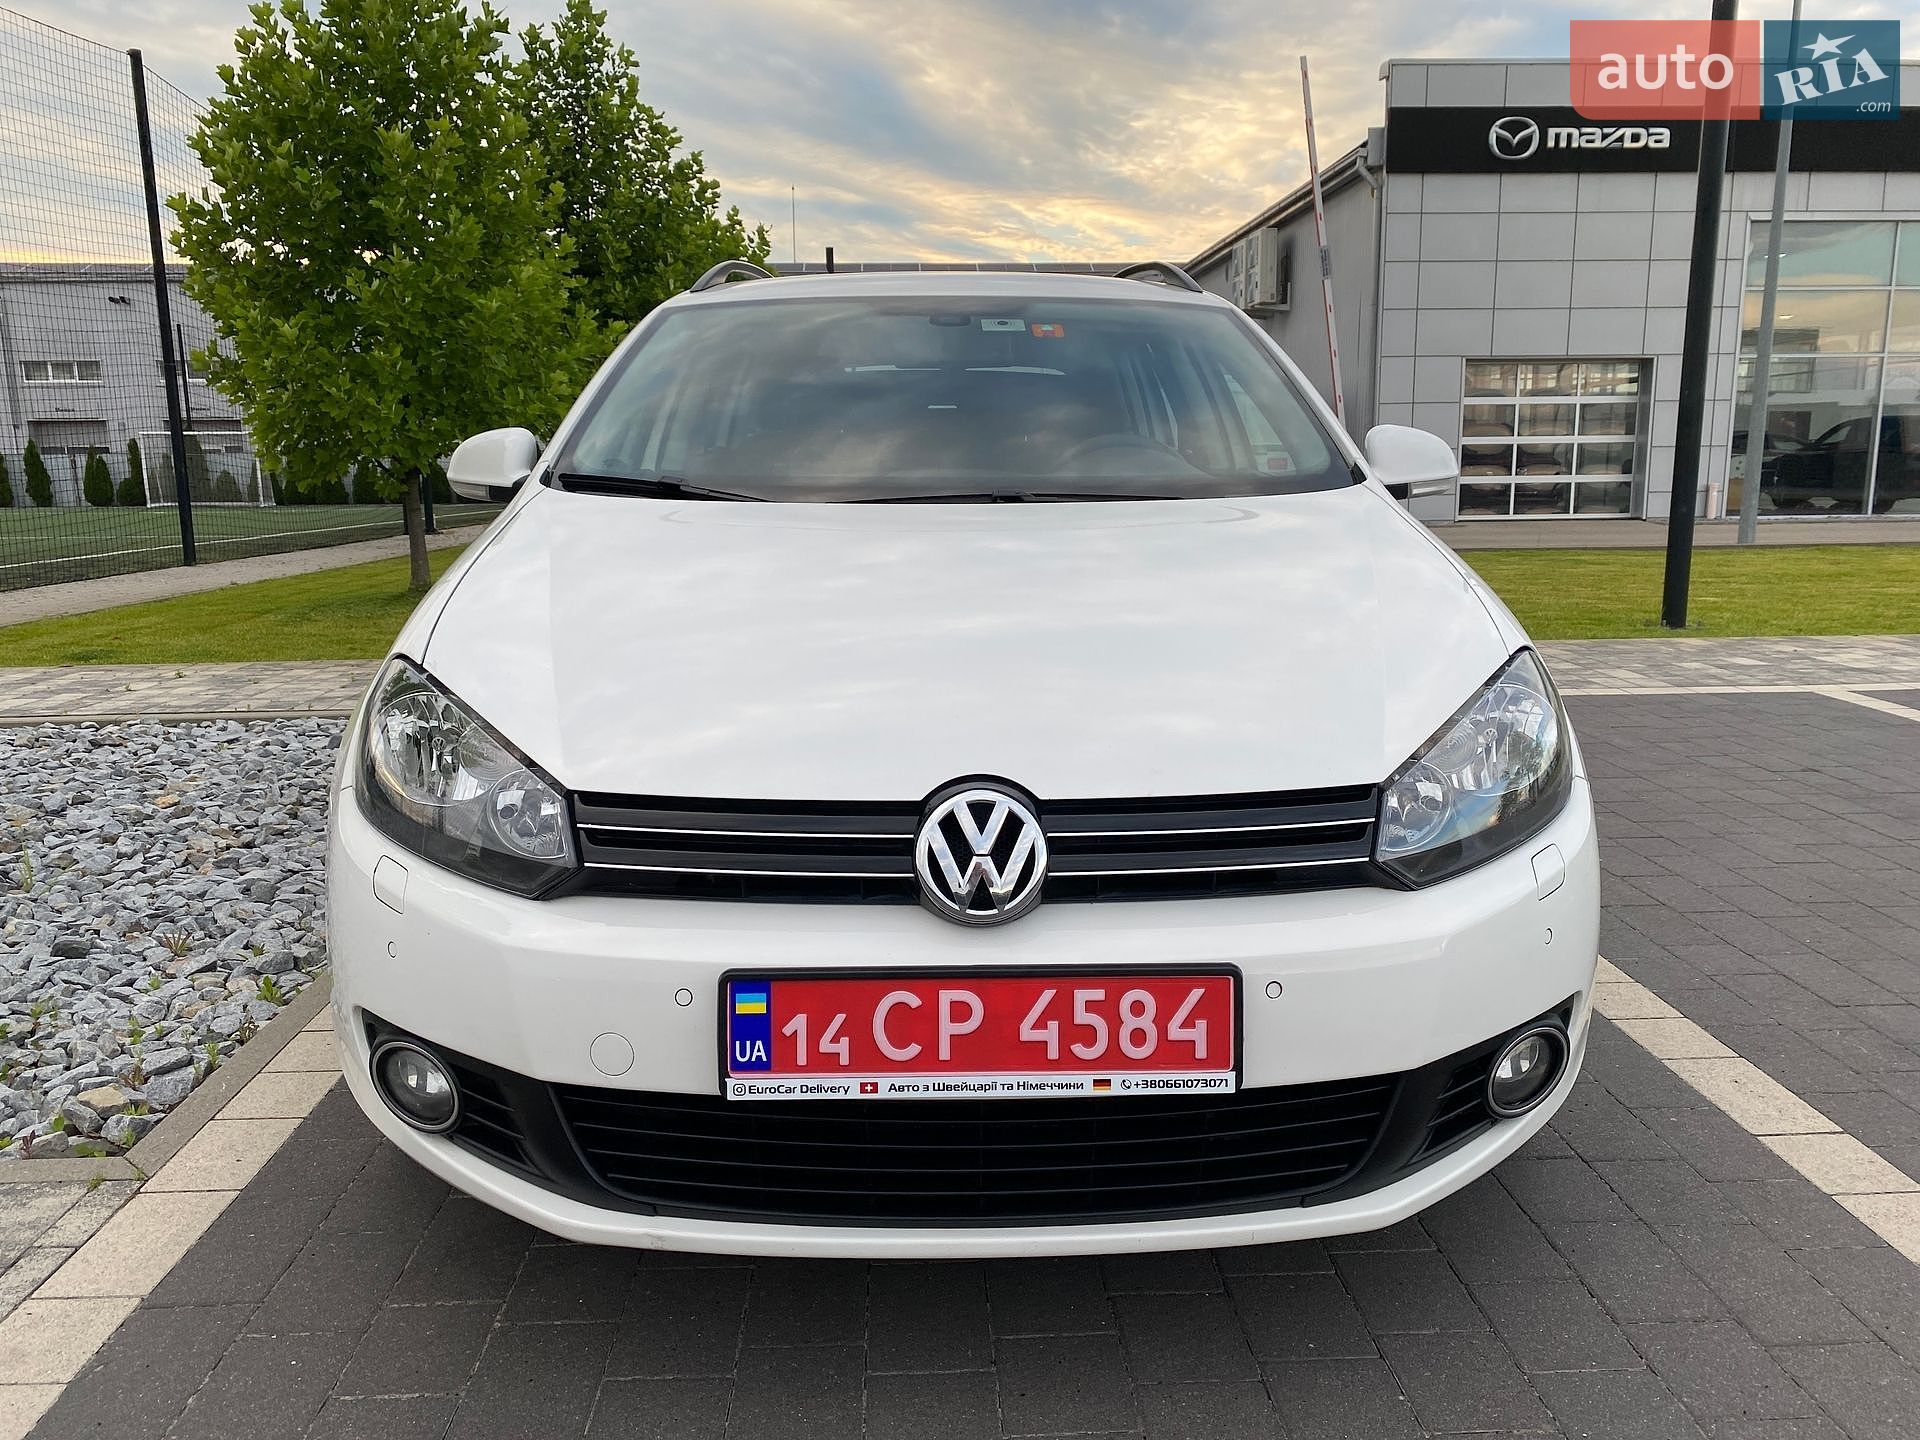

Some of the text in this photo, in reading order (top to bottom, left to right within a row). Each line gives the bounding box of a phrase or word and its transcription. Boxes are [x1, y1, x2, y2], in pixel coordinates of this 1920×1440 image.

[782, 988, 1208, 1066] 14 CP 4584
[735, 1040, 767, 1062] UA
[748, 1083, 851, 1096] EuroCar Delivery
[887, 1079, 1085, 1094] Авто з Швейцарії та Німеччини
[1133, 1077, 1229, 1090] +380661073071
